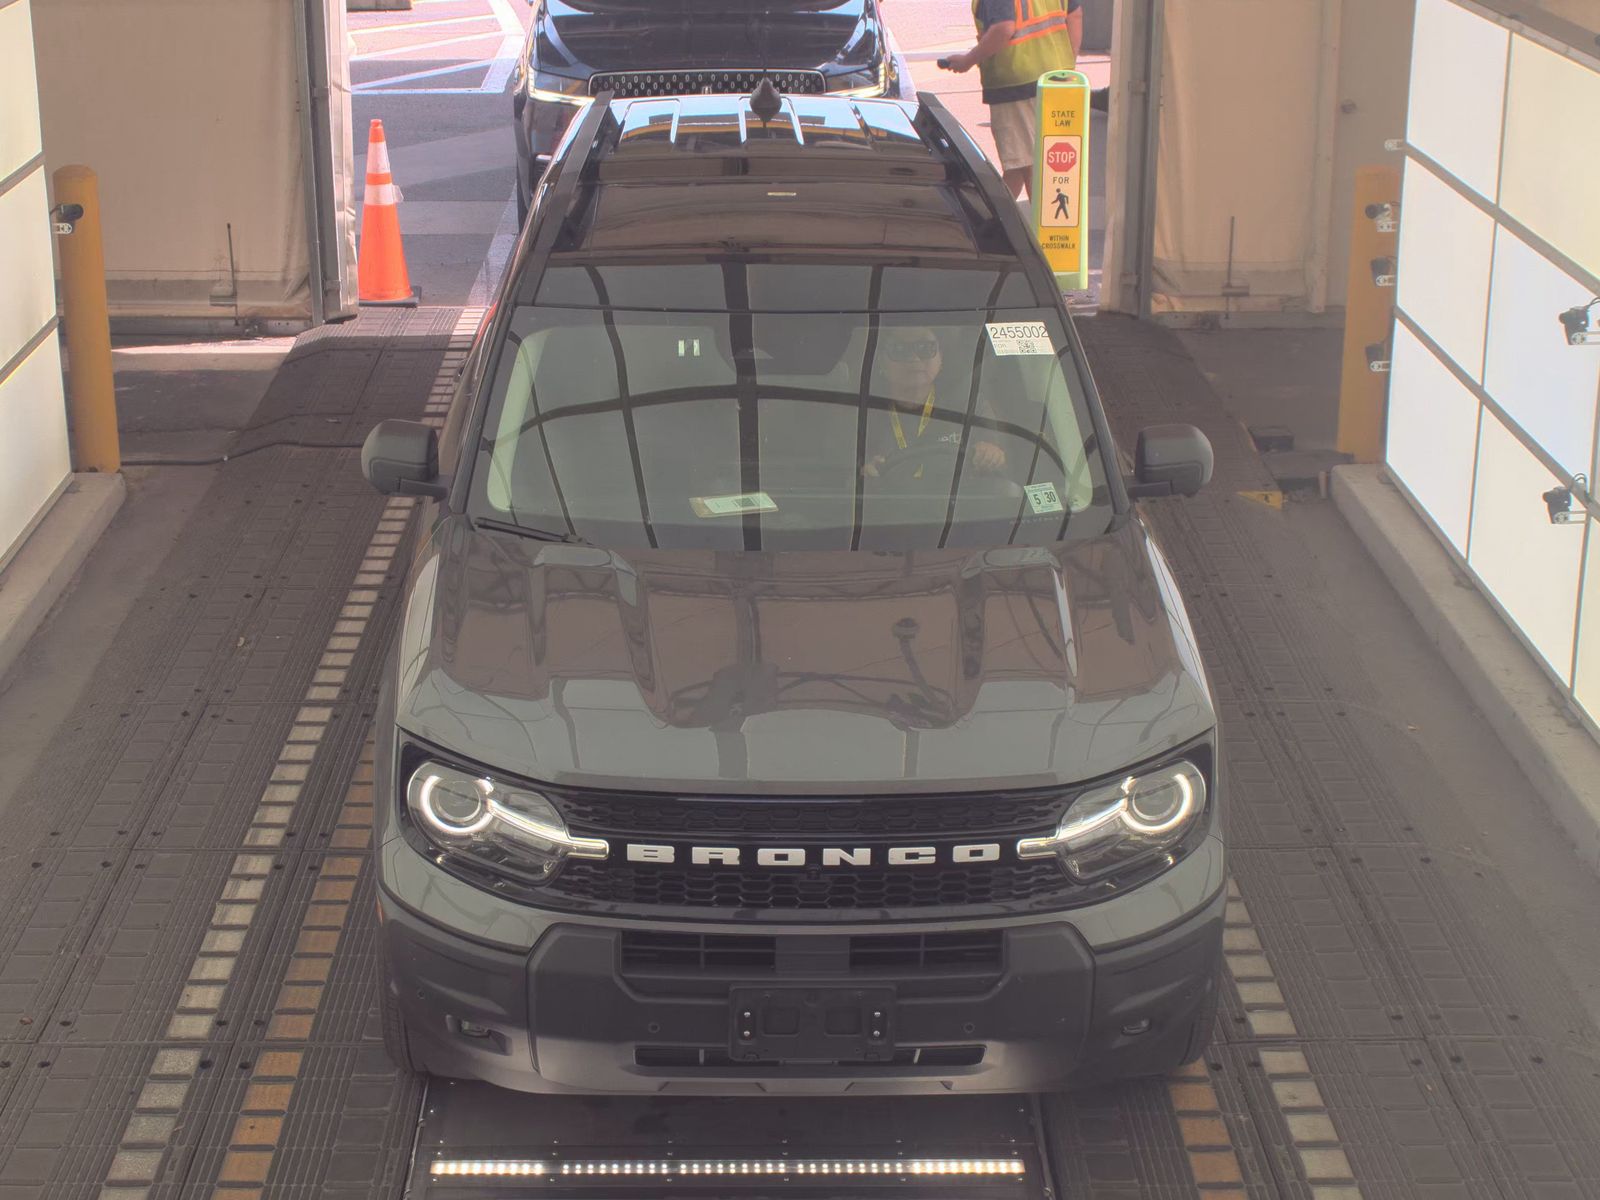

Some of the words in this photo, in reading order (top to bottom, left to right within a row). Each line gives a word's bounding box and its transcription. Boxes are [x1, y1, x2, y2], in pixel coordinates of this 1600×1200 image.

[1051, 110, 1075, 118] STATE
[1048, 151, 1076, 163] STOP
[1042, 242, 1075, 250] CROSSWALK
[990, 326, 1048, 339] 2455002
[1033, 494, 1041, 505] 5
[1044, 491, 1056, 503] 30
[626, 843, 1000, 866] BRONCO
